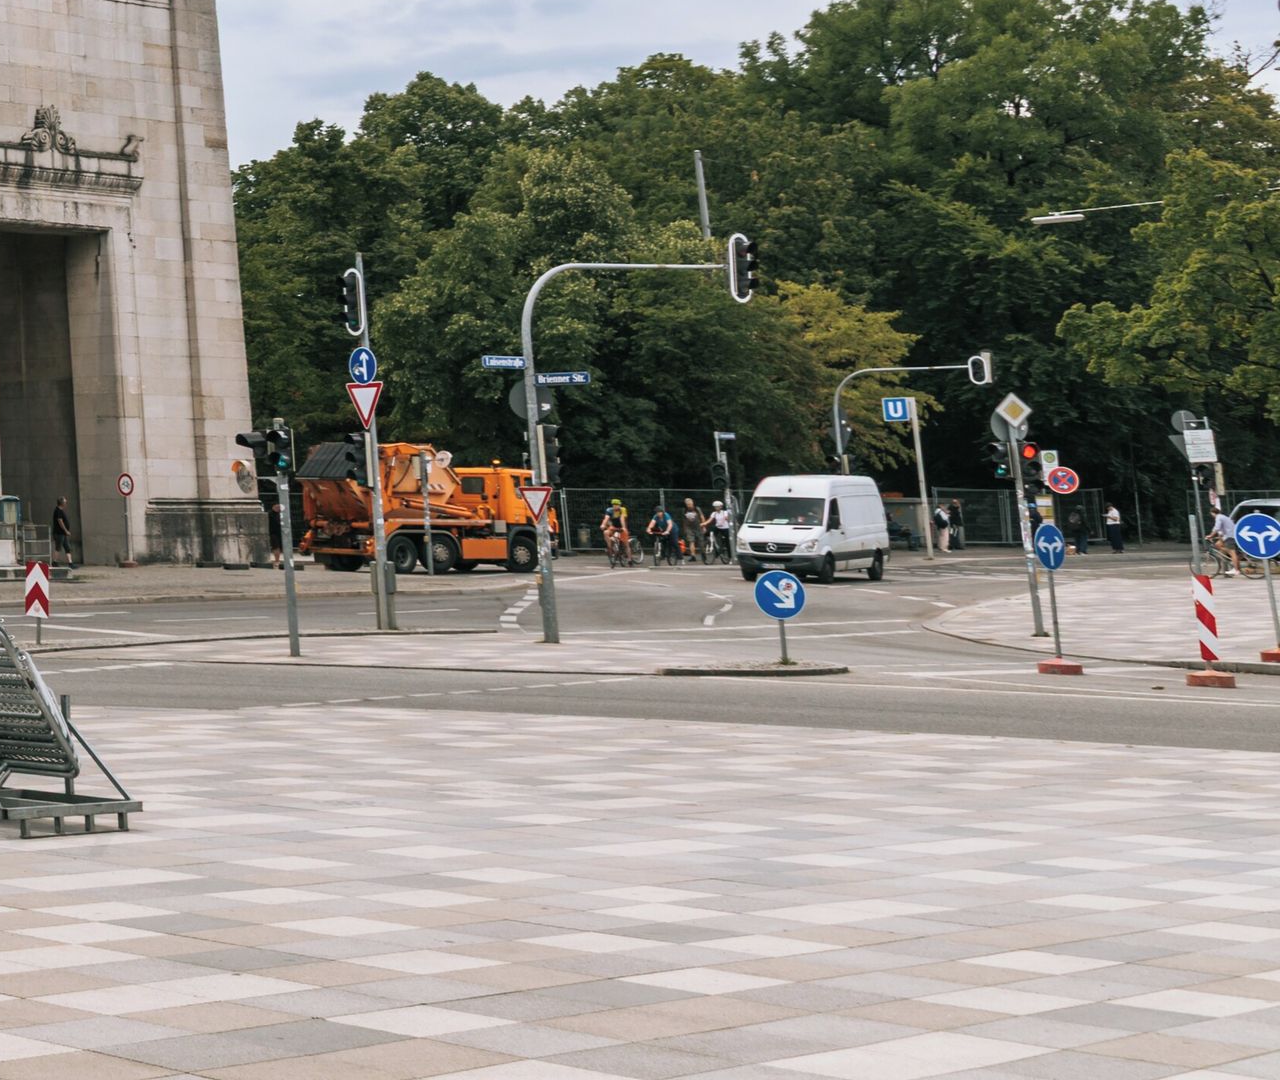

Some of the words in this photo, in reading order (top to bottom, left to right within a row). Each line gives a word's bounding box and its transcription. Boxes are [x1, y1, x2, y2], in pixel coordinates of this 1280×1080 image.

[538, 375, 570, 384] Brienner
[572, 373, 586, 383] Str.
[888, 401, 903, 418] U
